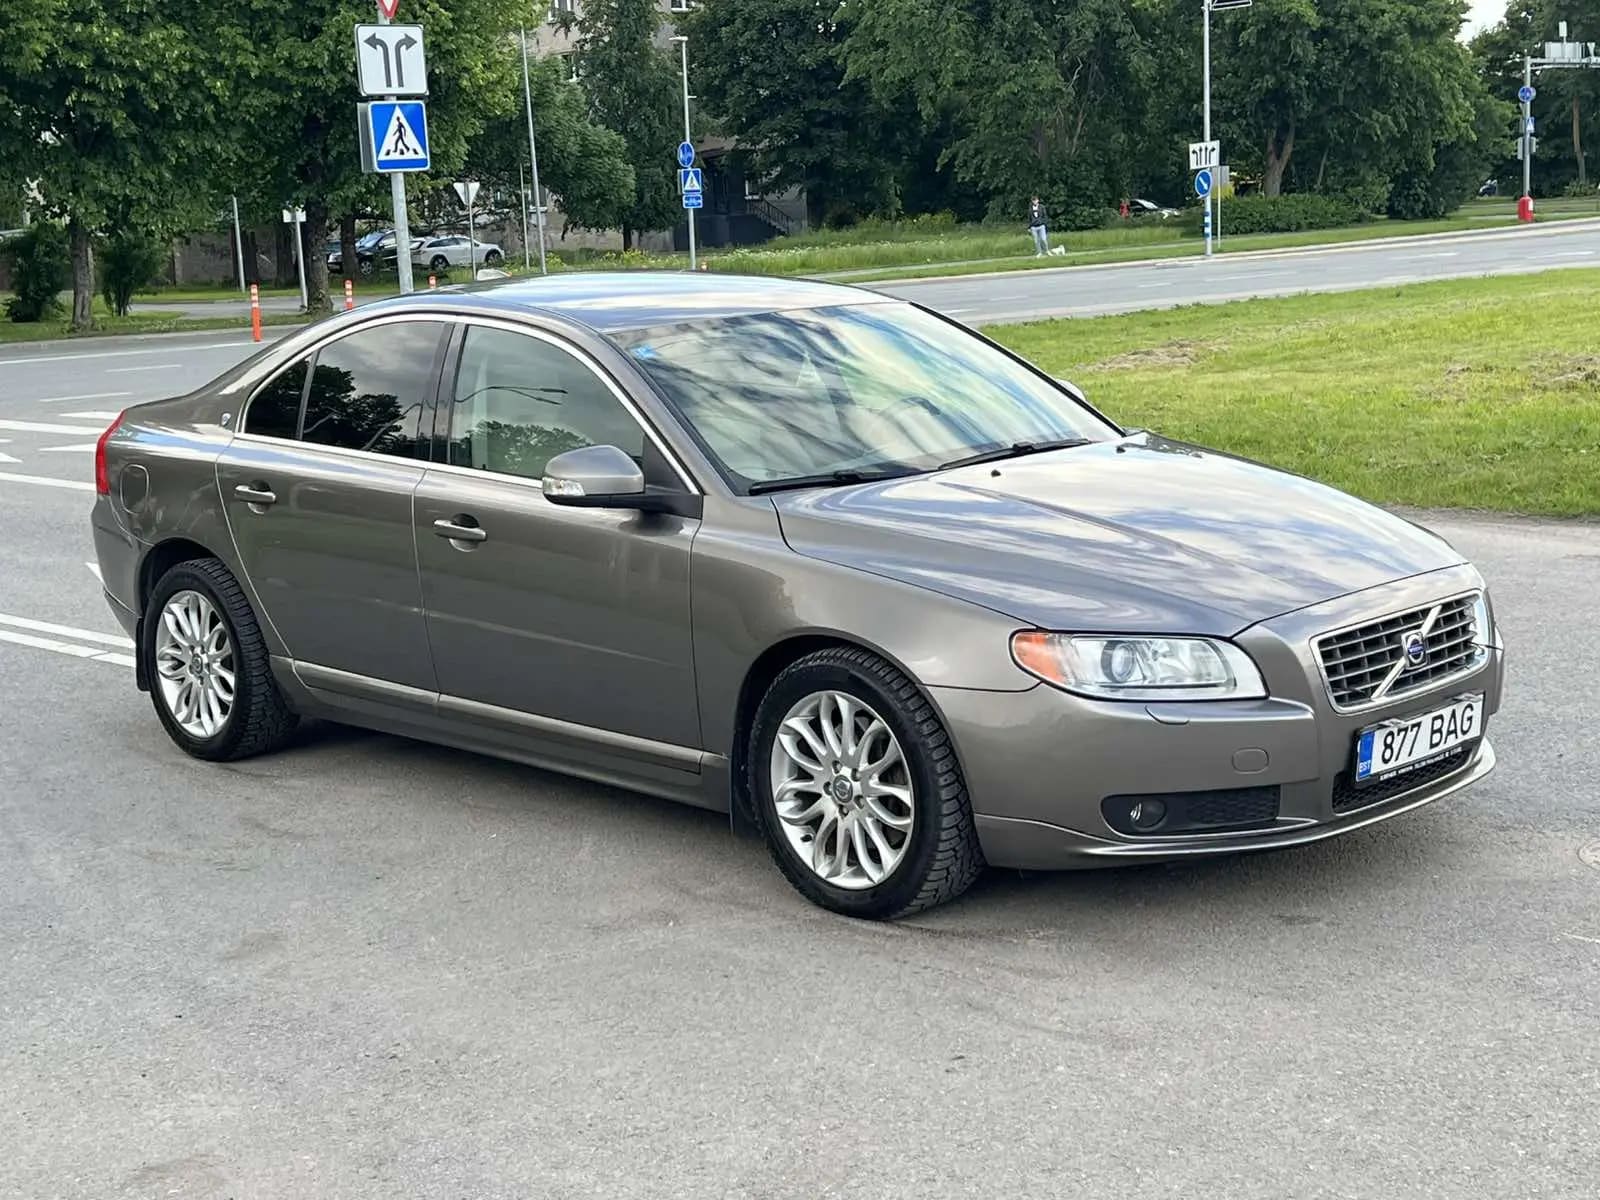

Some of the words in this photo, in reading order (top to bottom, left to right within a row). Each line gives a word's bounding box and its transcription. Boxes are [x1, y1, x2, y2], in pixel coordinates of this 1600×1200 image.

[1381, 721, 1422, 764] 877
[1429, 703, 1474, 749] BAG
[1359, 760, 1371, 773] EST
